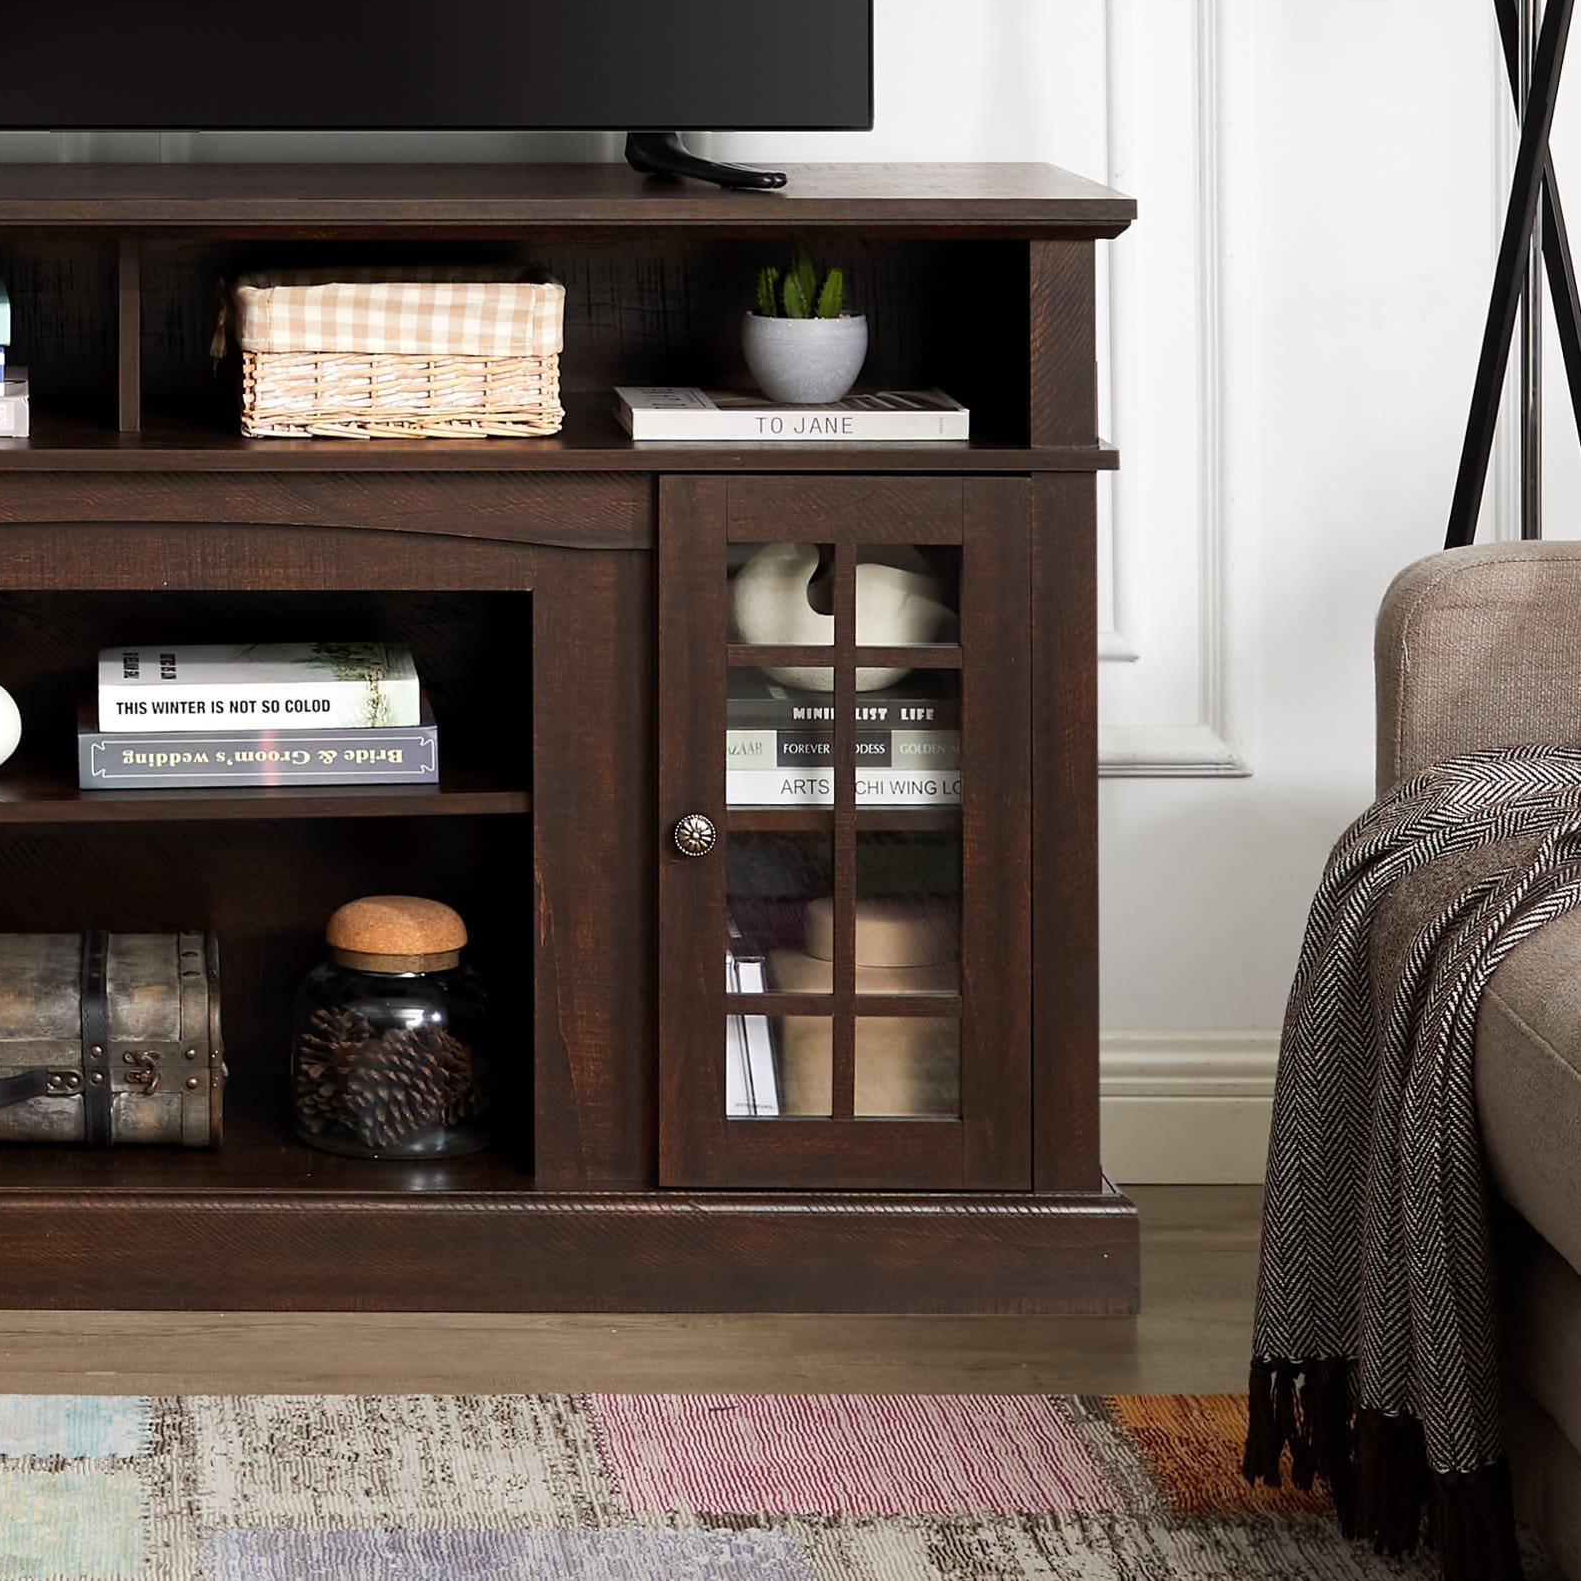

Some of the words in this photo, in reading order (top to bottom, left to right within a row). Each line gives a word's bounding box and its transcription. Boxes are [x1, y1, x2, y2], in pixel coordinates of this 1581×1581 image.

[755, 417, 784, 434] TO
[793, 417, 854, 434] JANE
[116, 702, 147, 715] THIS
[152, 701, 206, 715] WINTER
[211, 700, 224, 714] IS
[229, 700, 257, 714] NOT
[262, 699, 280, 713] SO
[285, 699, 331, 713] COLOD
[900, 708, 935, 720] LIFE
[343, 748, 404, 764] Bride
[783, 743, 831, 754] FOREVER
[122, 749, 210, 765] wedding
[317, 750, 338, 764] &
[780, 779, 830, 795] ARTS
[889, 780, 937, 795] WING
